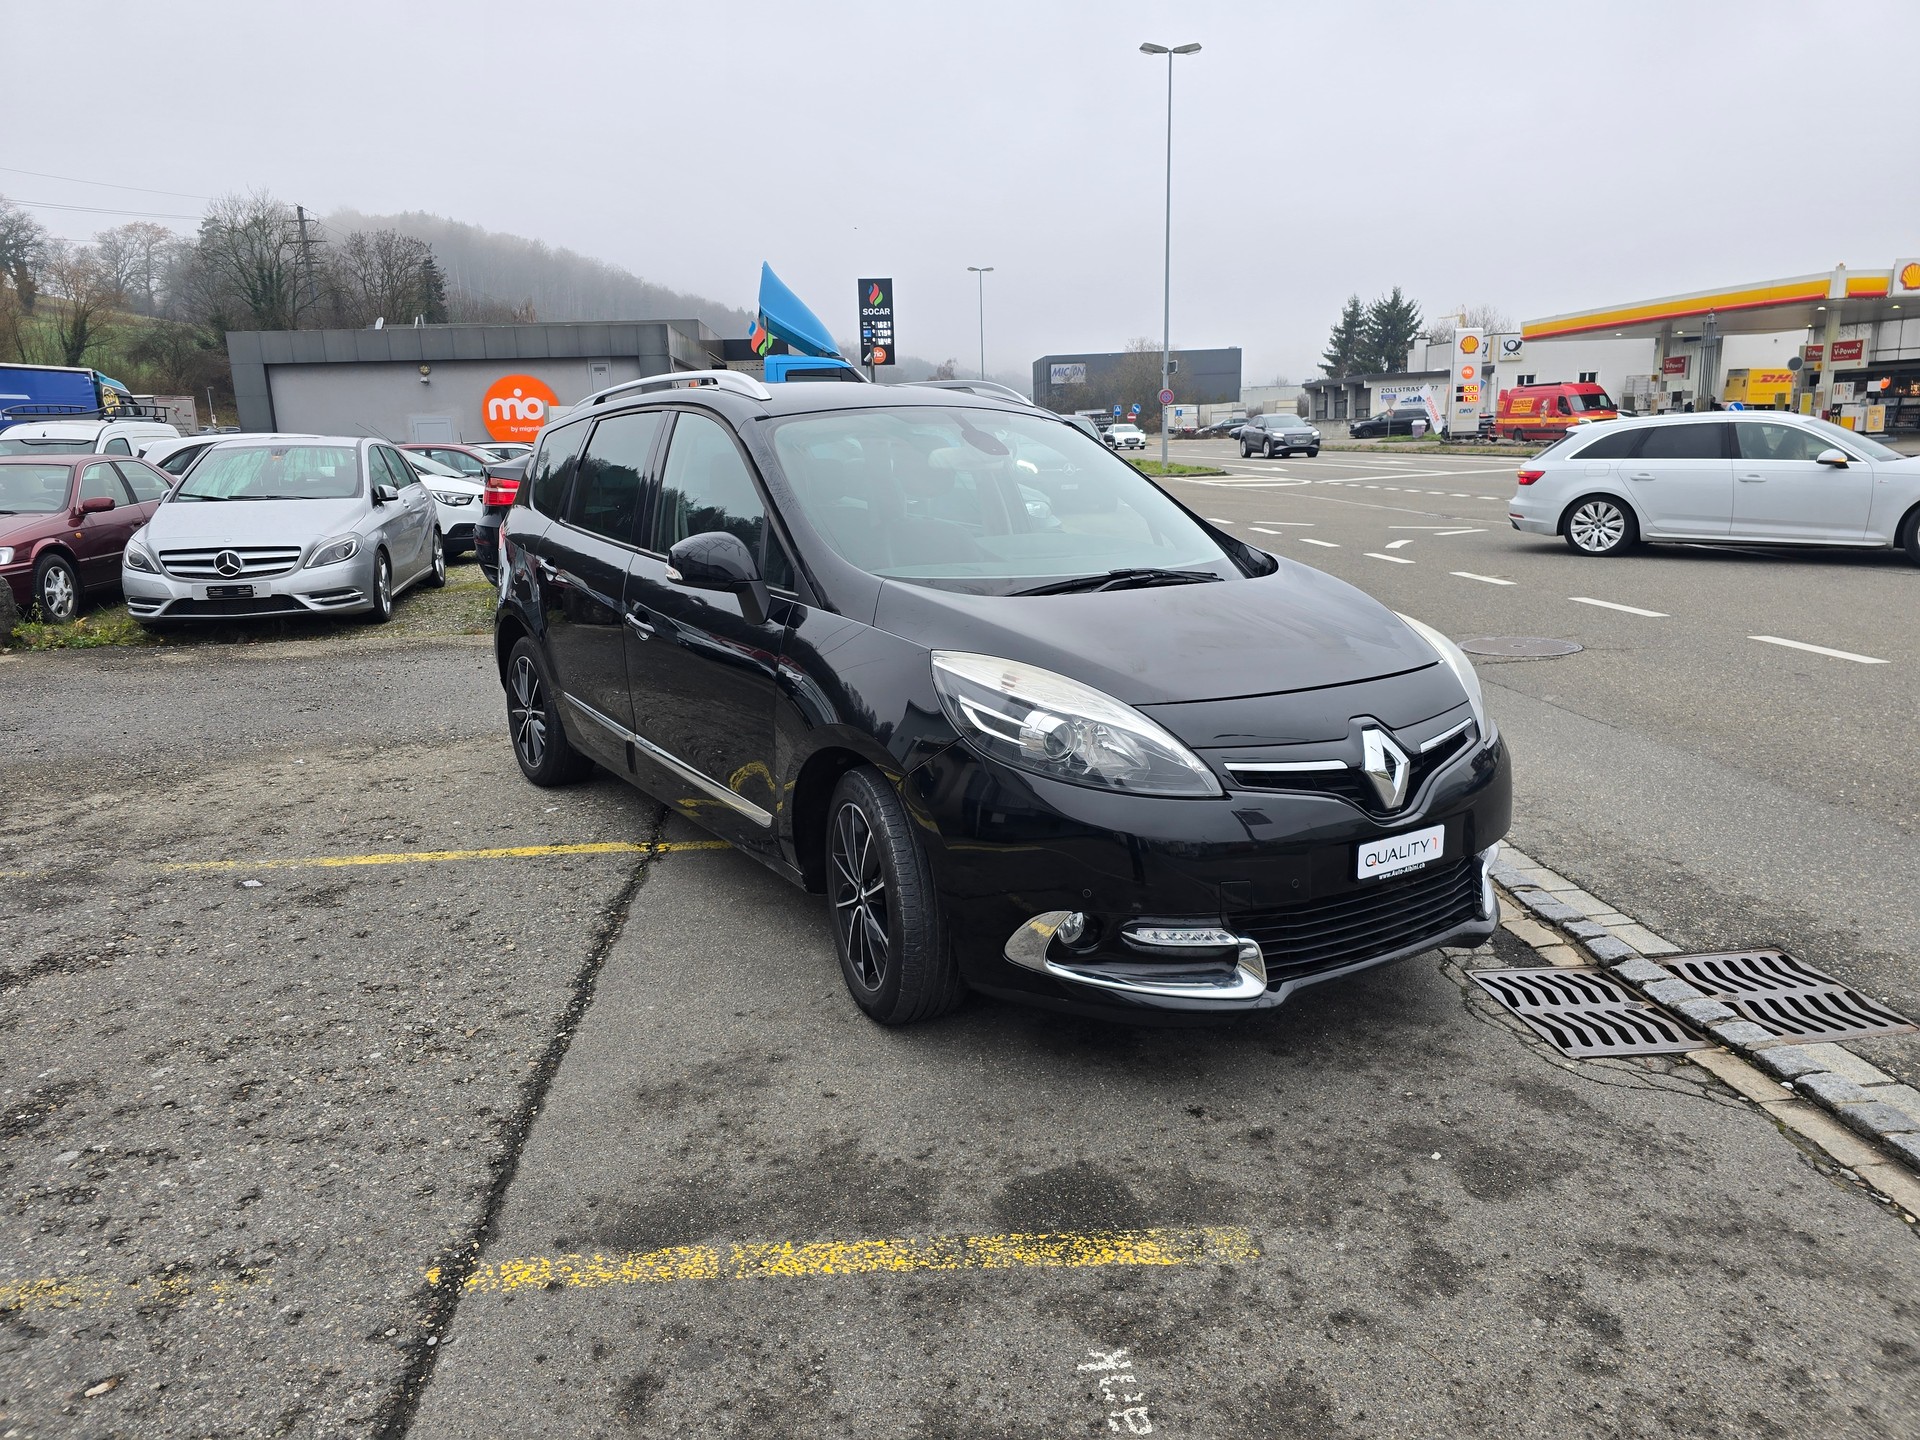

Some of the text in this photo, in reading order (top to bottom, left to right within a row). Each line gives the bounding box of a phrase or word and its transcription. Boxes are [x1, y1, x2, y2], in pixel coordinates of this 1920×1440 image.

[1052, 367, 1085, 377] MICON
[488, 388, 544, 420] mio
[1427, 396, 1440, 423] MIGROS
[1379, 862, 1425, 880] www.Auto-Albini.ch
